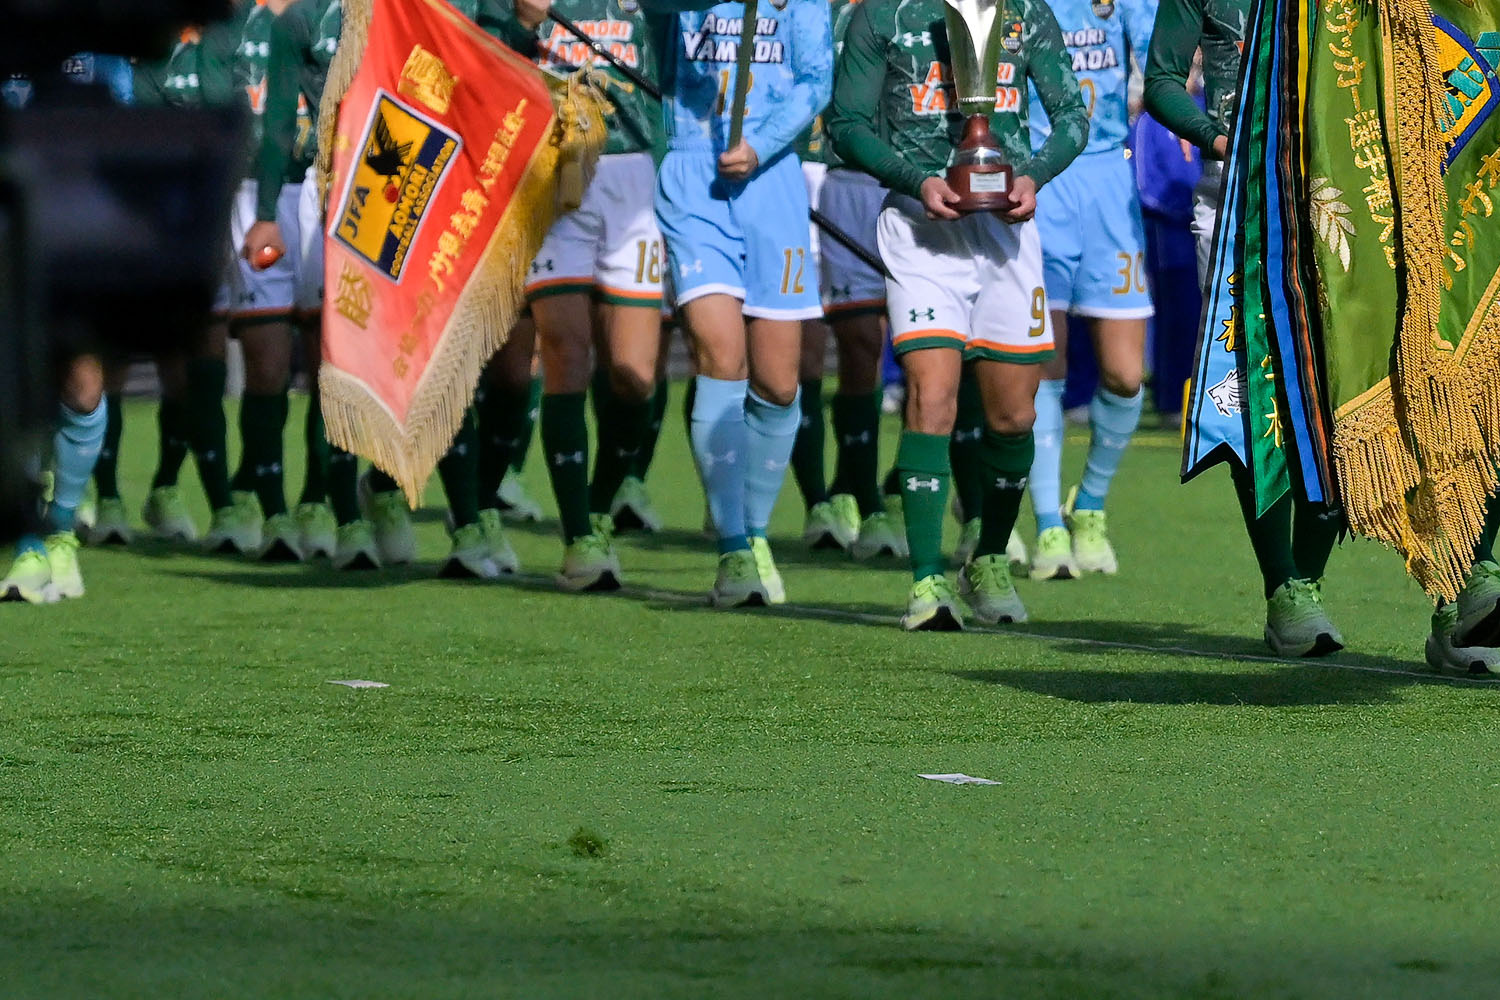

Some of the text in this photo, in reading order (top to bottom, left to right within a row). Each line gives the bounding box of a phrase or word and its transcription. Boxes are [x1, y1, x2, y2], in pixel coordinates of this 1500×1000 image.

[550, 21, 633, 41] AMORI
[701, 13, 778, 36] AOMRI
[1061, 28, 1106, 47] MORI
[682, 31, 784, 63] YAMDA
[1071, 46, 1117, 72] ADA
[907, 83, 1020, 115] YADA
[345, 185, 371, 239] JFA
[388, 163, 429, 240] AOMORI
[635, 240, 661, 283] 18
[780, 248, 806, 294] 12
[1112, 252, 1145, 294] 30
[1028, 286, 1047, 338] 9
